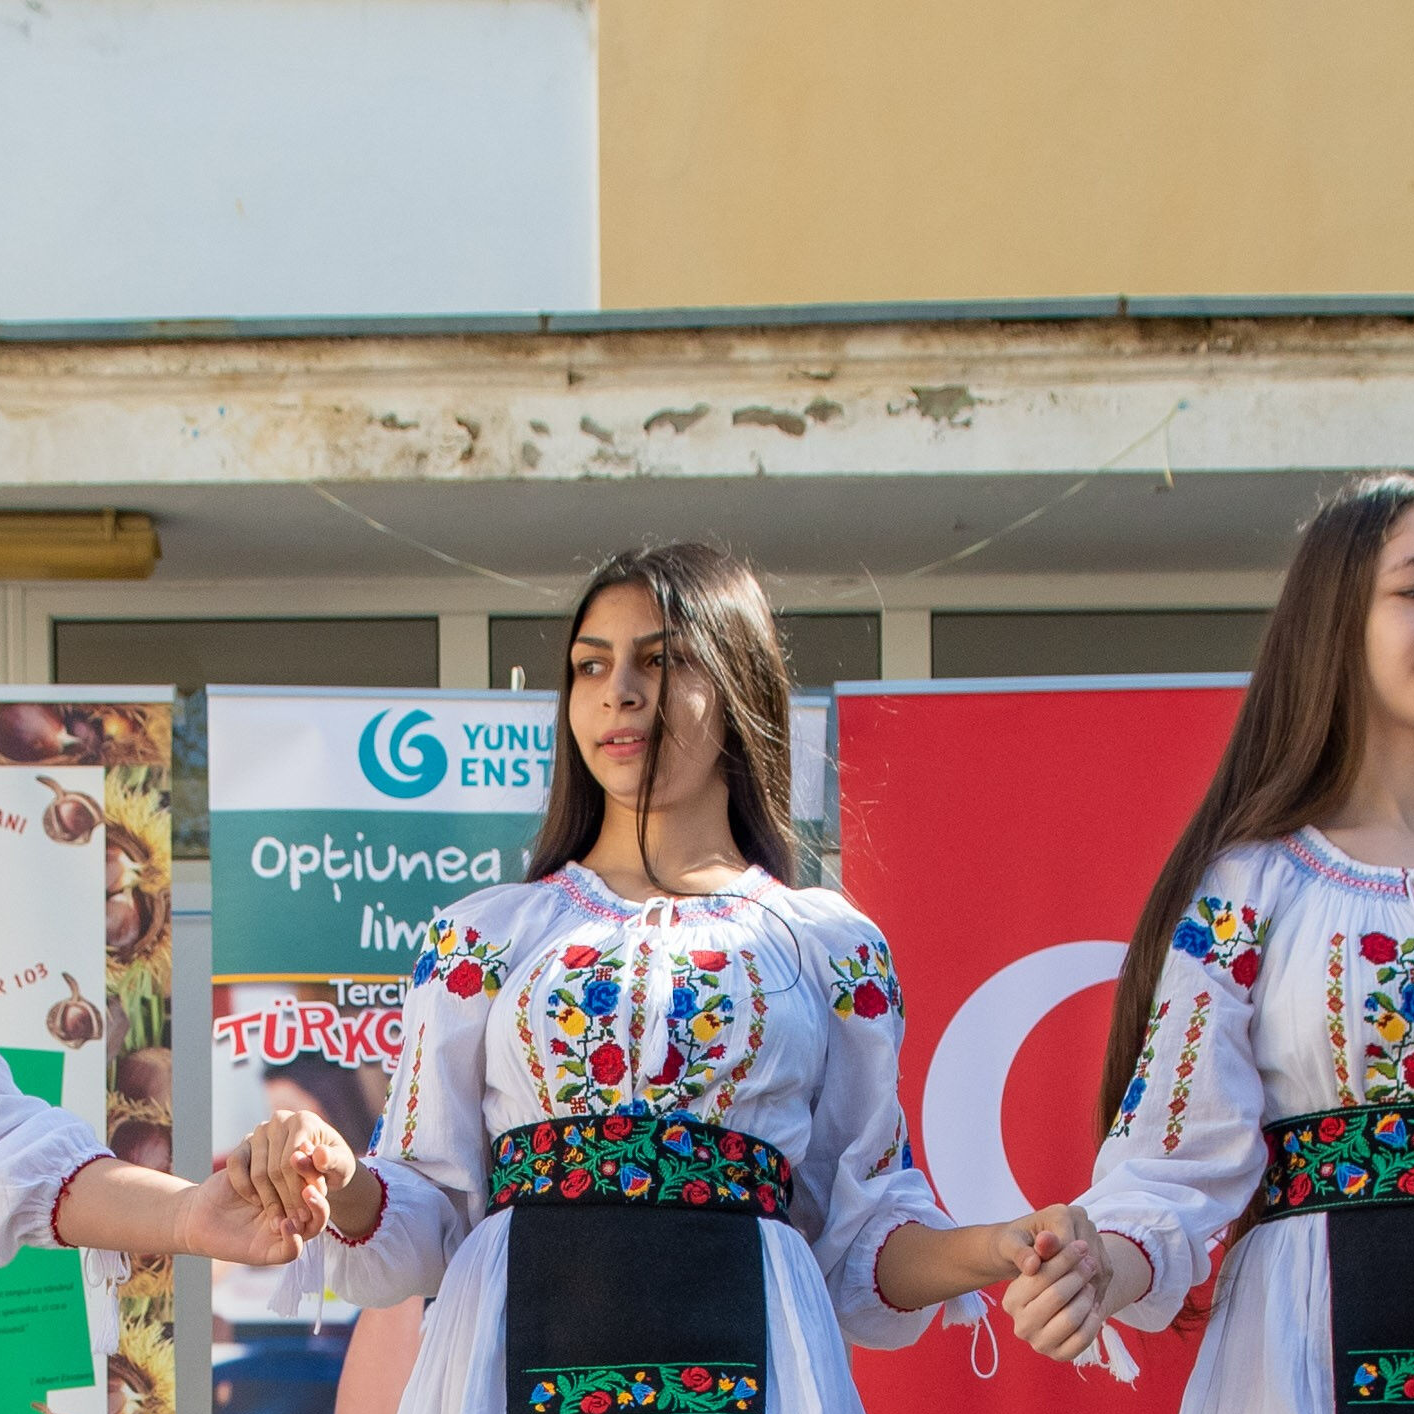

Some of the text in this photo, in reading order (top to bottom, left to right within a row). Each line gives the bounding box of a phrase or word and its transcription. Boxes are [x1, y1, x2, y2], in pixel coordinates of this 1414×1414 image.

[462, 723, 554, 750] YUNU
[461, 757, 554, 787] ENST
[250, 832, 501, 902] Opțiunea
[360, 901, 441, 951] lim
[14, 963, 49, 989] 103
[329, 978, 412, 1007] Terci
